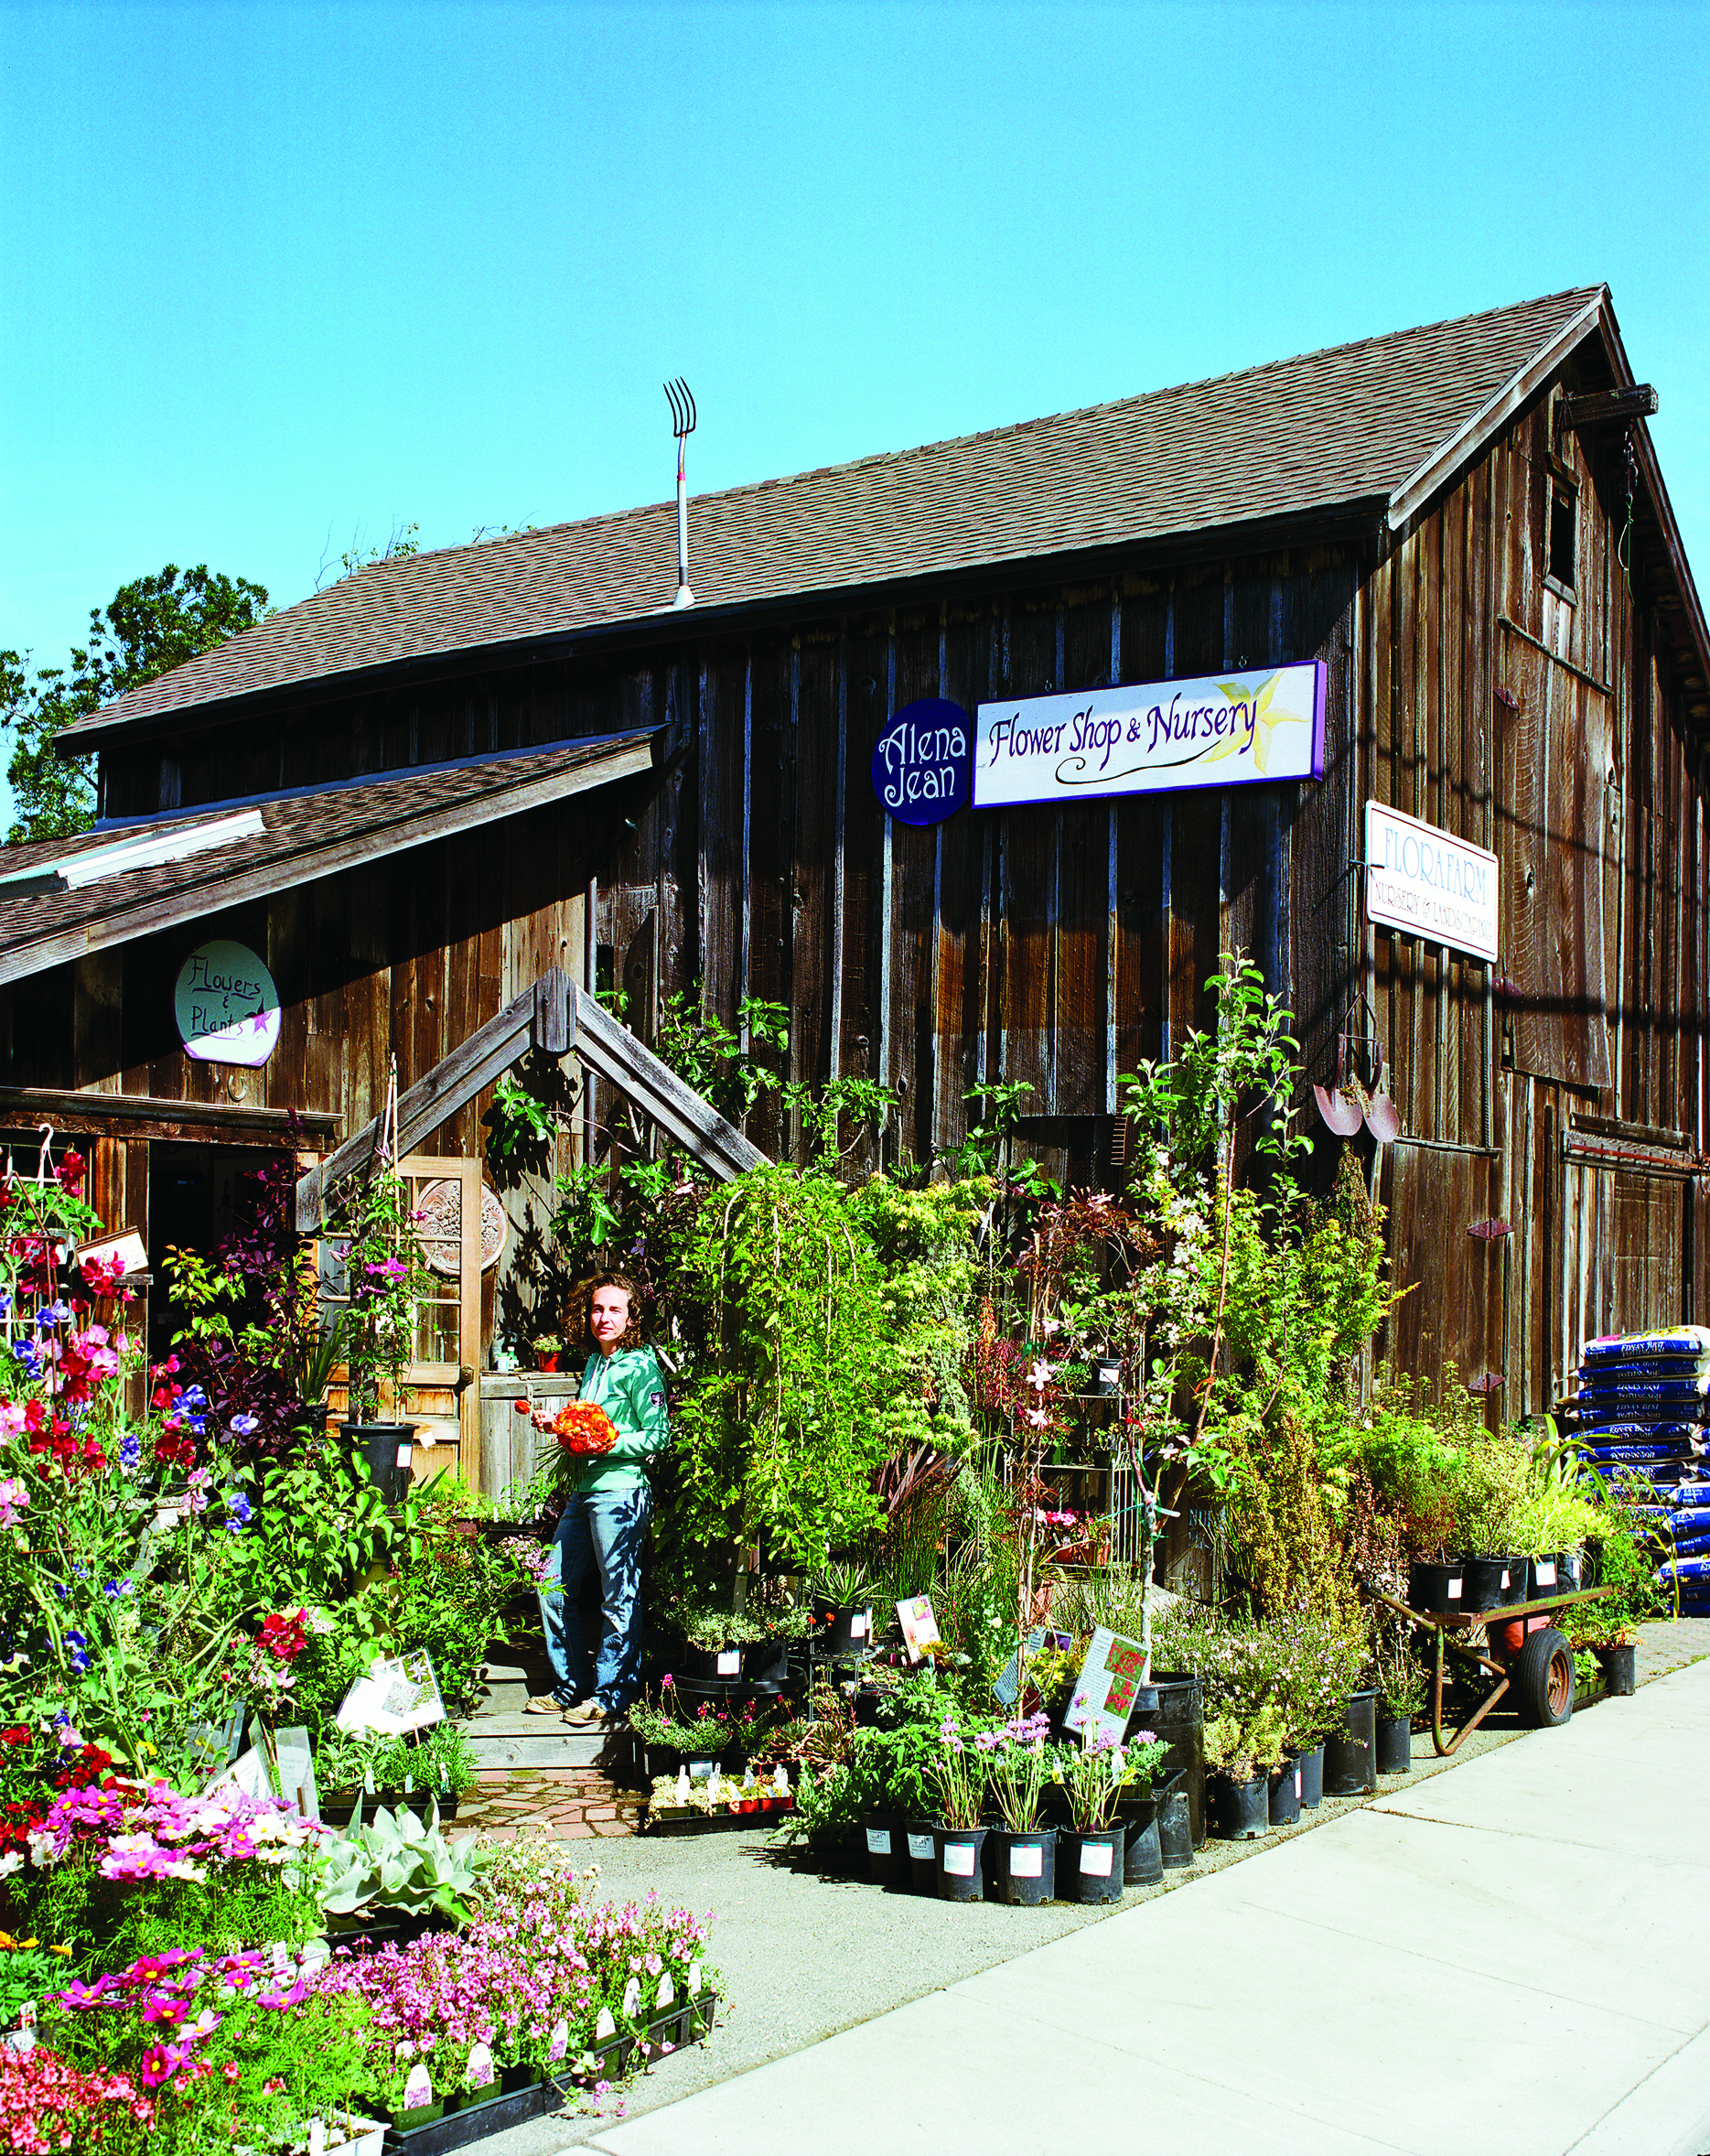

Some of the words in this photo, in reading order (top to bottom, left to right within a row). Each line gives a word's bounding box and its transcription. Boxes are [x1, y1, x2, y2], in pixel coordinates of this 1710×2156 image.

[878, 722, 966, 774] Alena
[988, 712, 1067, 768] Flower
[1069, 705, 1122, 771] Shop
[1126, 717, 1142, 740] &
[1145, 691, 1259, 755] Nursery
[884, 765, 955, 808] Jean
[1375, 881, 1420, 914] NURSERY
[1421, 897, 1431, 919] &
[1433, 901, 1492, 942] LANDSCAPING
[187, 954, 262, 997] Flowers
[190, 1006, 244, 1036] Plants
